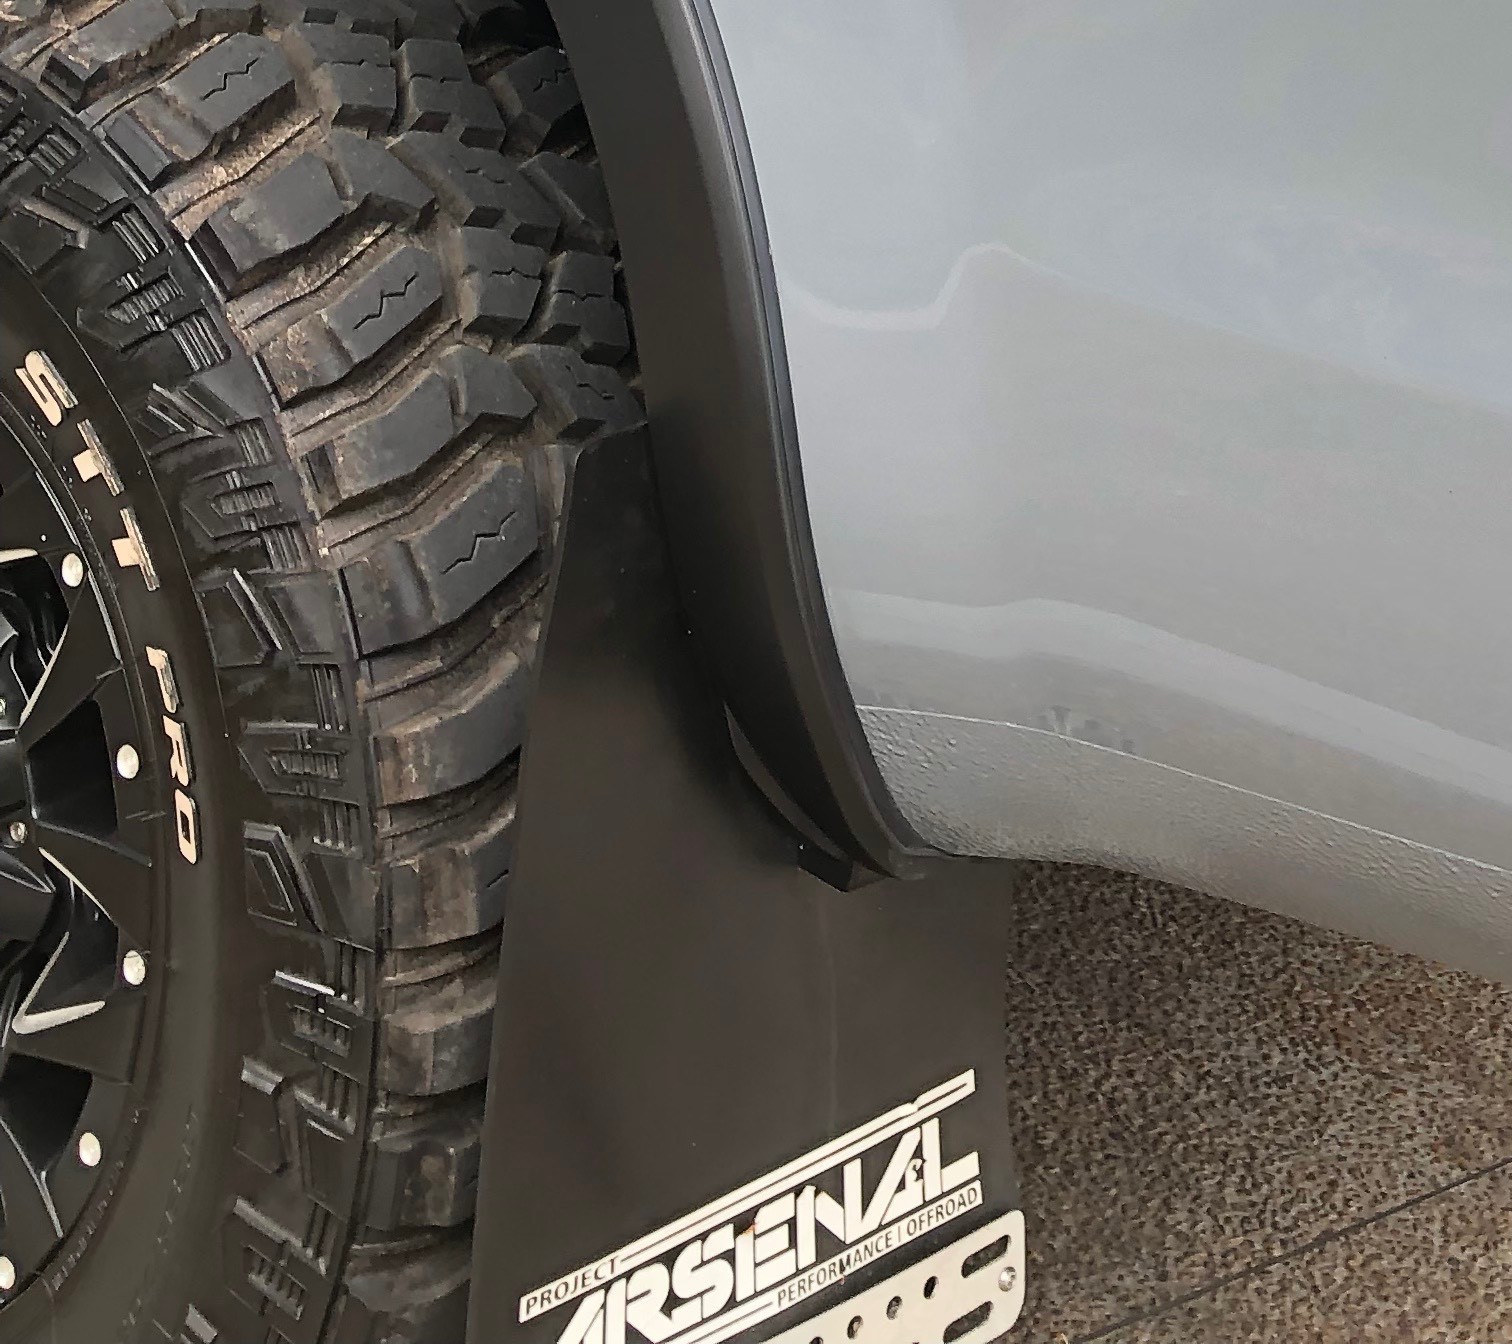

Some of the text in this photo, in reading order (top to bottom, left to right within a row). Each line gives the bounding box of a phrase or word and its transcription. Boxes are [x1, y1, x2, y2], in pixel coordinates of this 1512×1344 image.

[15, 348, 203, 866] STT PRO
[525, 1258, 619, 1316] PROJECT
[555, 1116, 980, 1344] ARSENAL
[776, 1186, 980, 1309] PERFORMANCE OFFROAD
